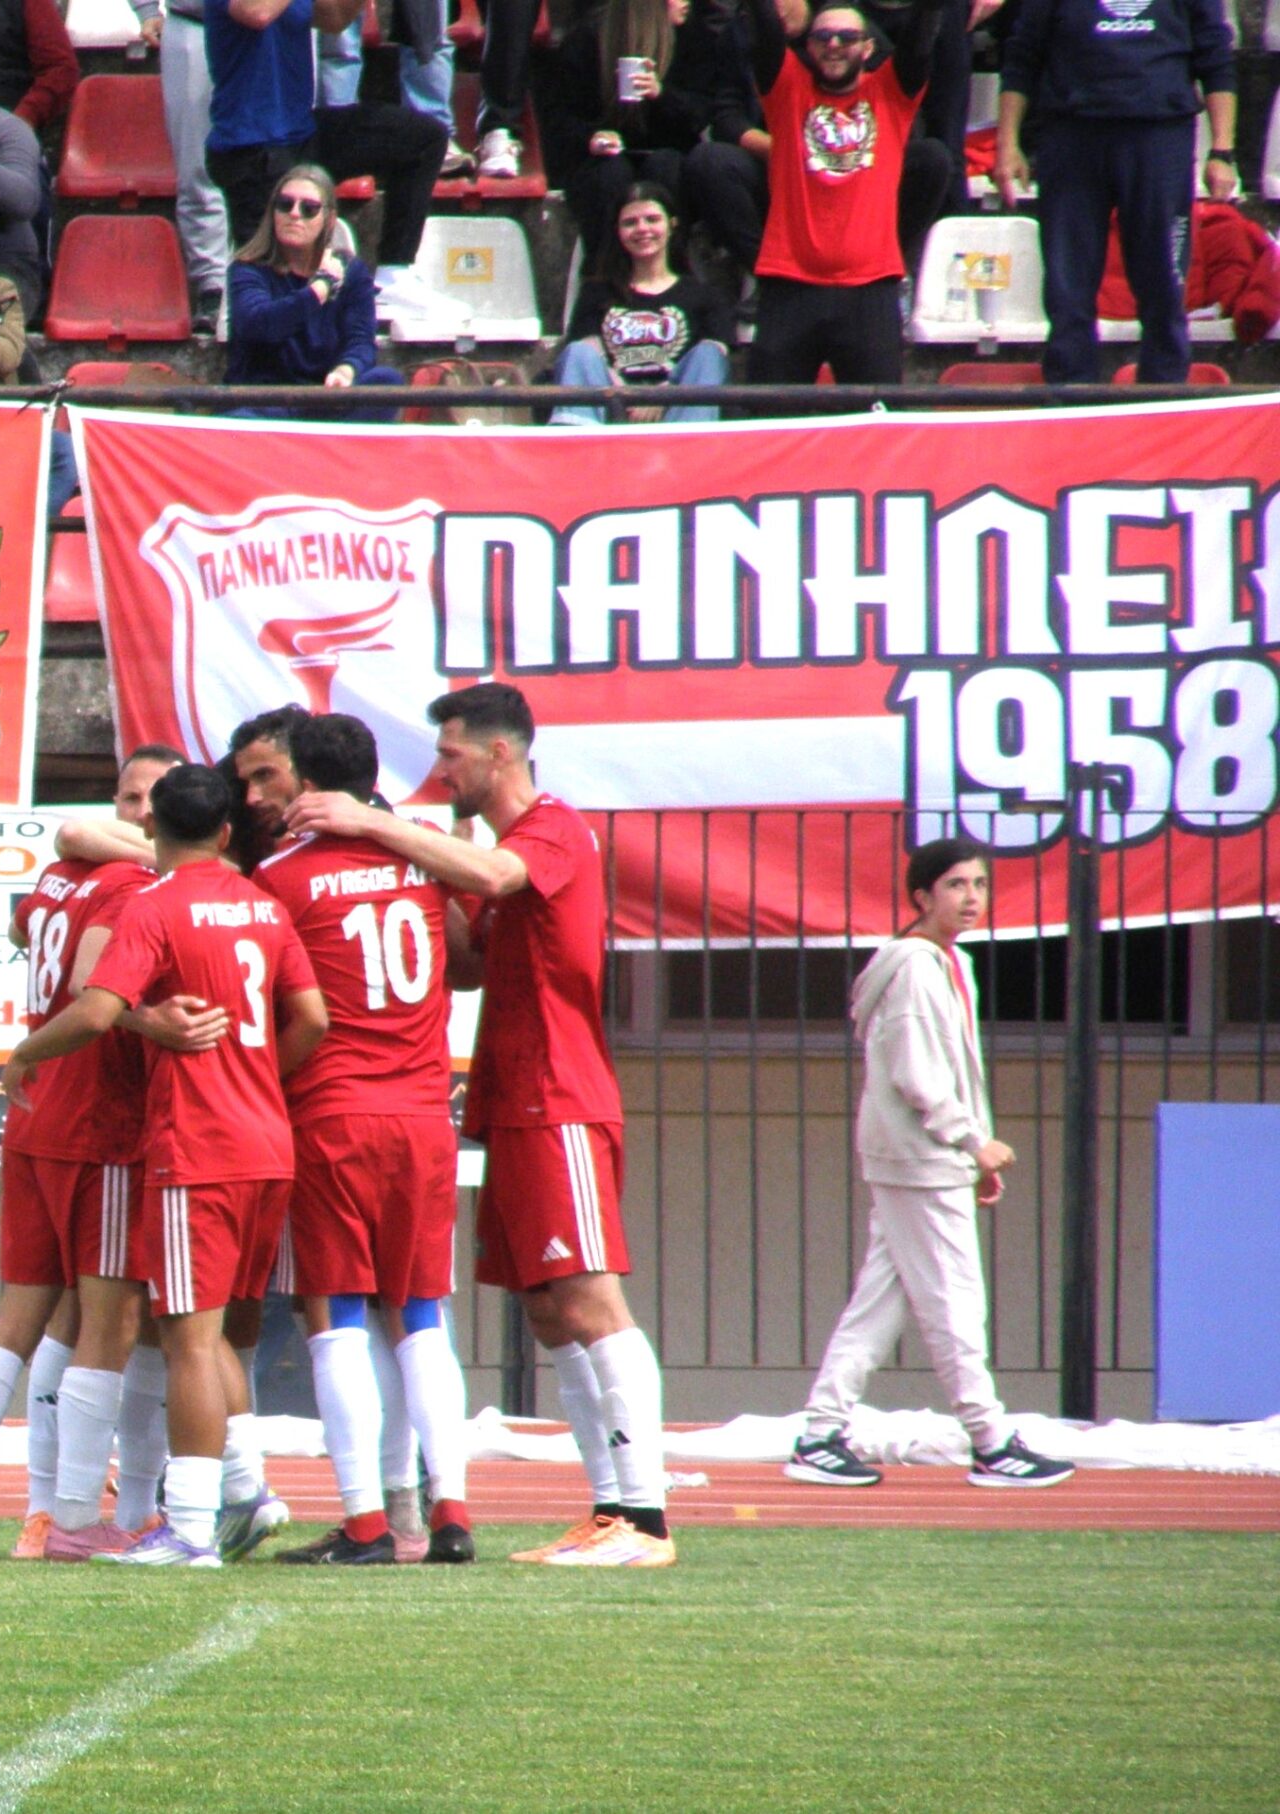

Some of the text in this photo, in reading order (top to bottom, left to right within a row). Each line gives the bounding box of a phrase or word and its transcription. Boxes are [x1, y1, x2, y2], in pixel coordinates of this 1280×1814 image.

[197, 532, 416, 601] ΠΑΝΗΛΕΙΑΚΟΣ
[890, 656, 1280, 850] 1958
[309, 865, 397, 901] PYRGOS
[27, 906, 69, 1015] 18
[234, 938, 267, 1048] 3
[340, 899, 432, 1011] 10
